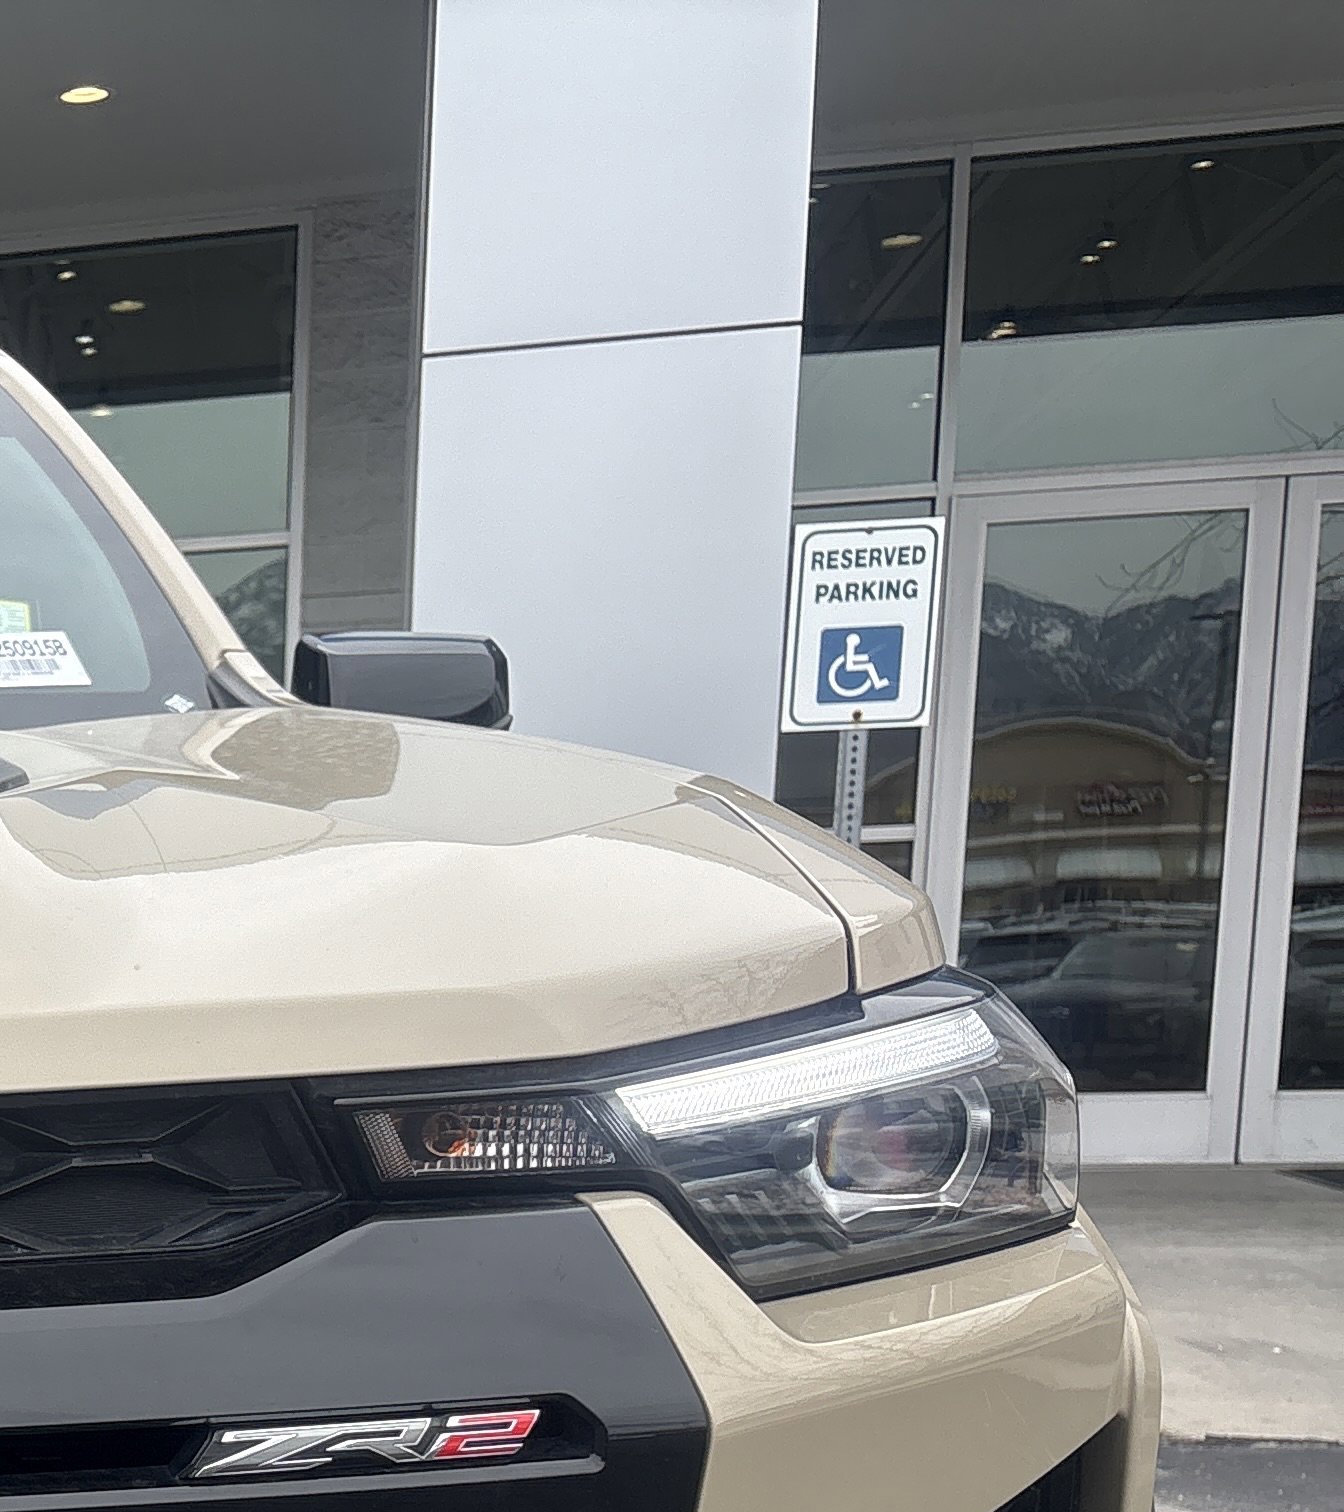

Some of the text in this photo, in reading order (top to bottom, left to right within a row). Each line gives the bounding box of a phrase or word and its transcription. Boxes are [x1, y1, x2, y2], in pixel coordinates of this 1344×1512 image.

[812, 545, 927, 571] RESERVED
[815, 579, 919, 604] PARKING
[194, 1410, 541, 1477] ZR2
